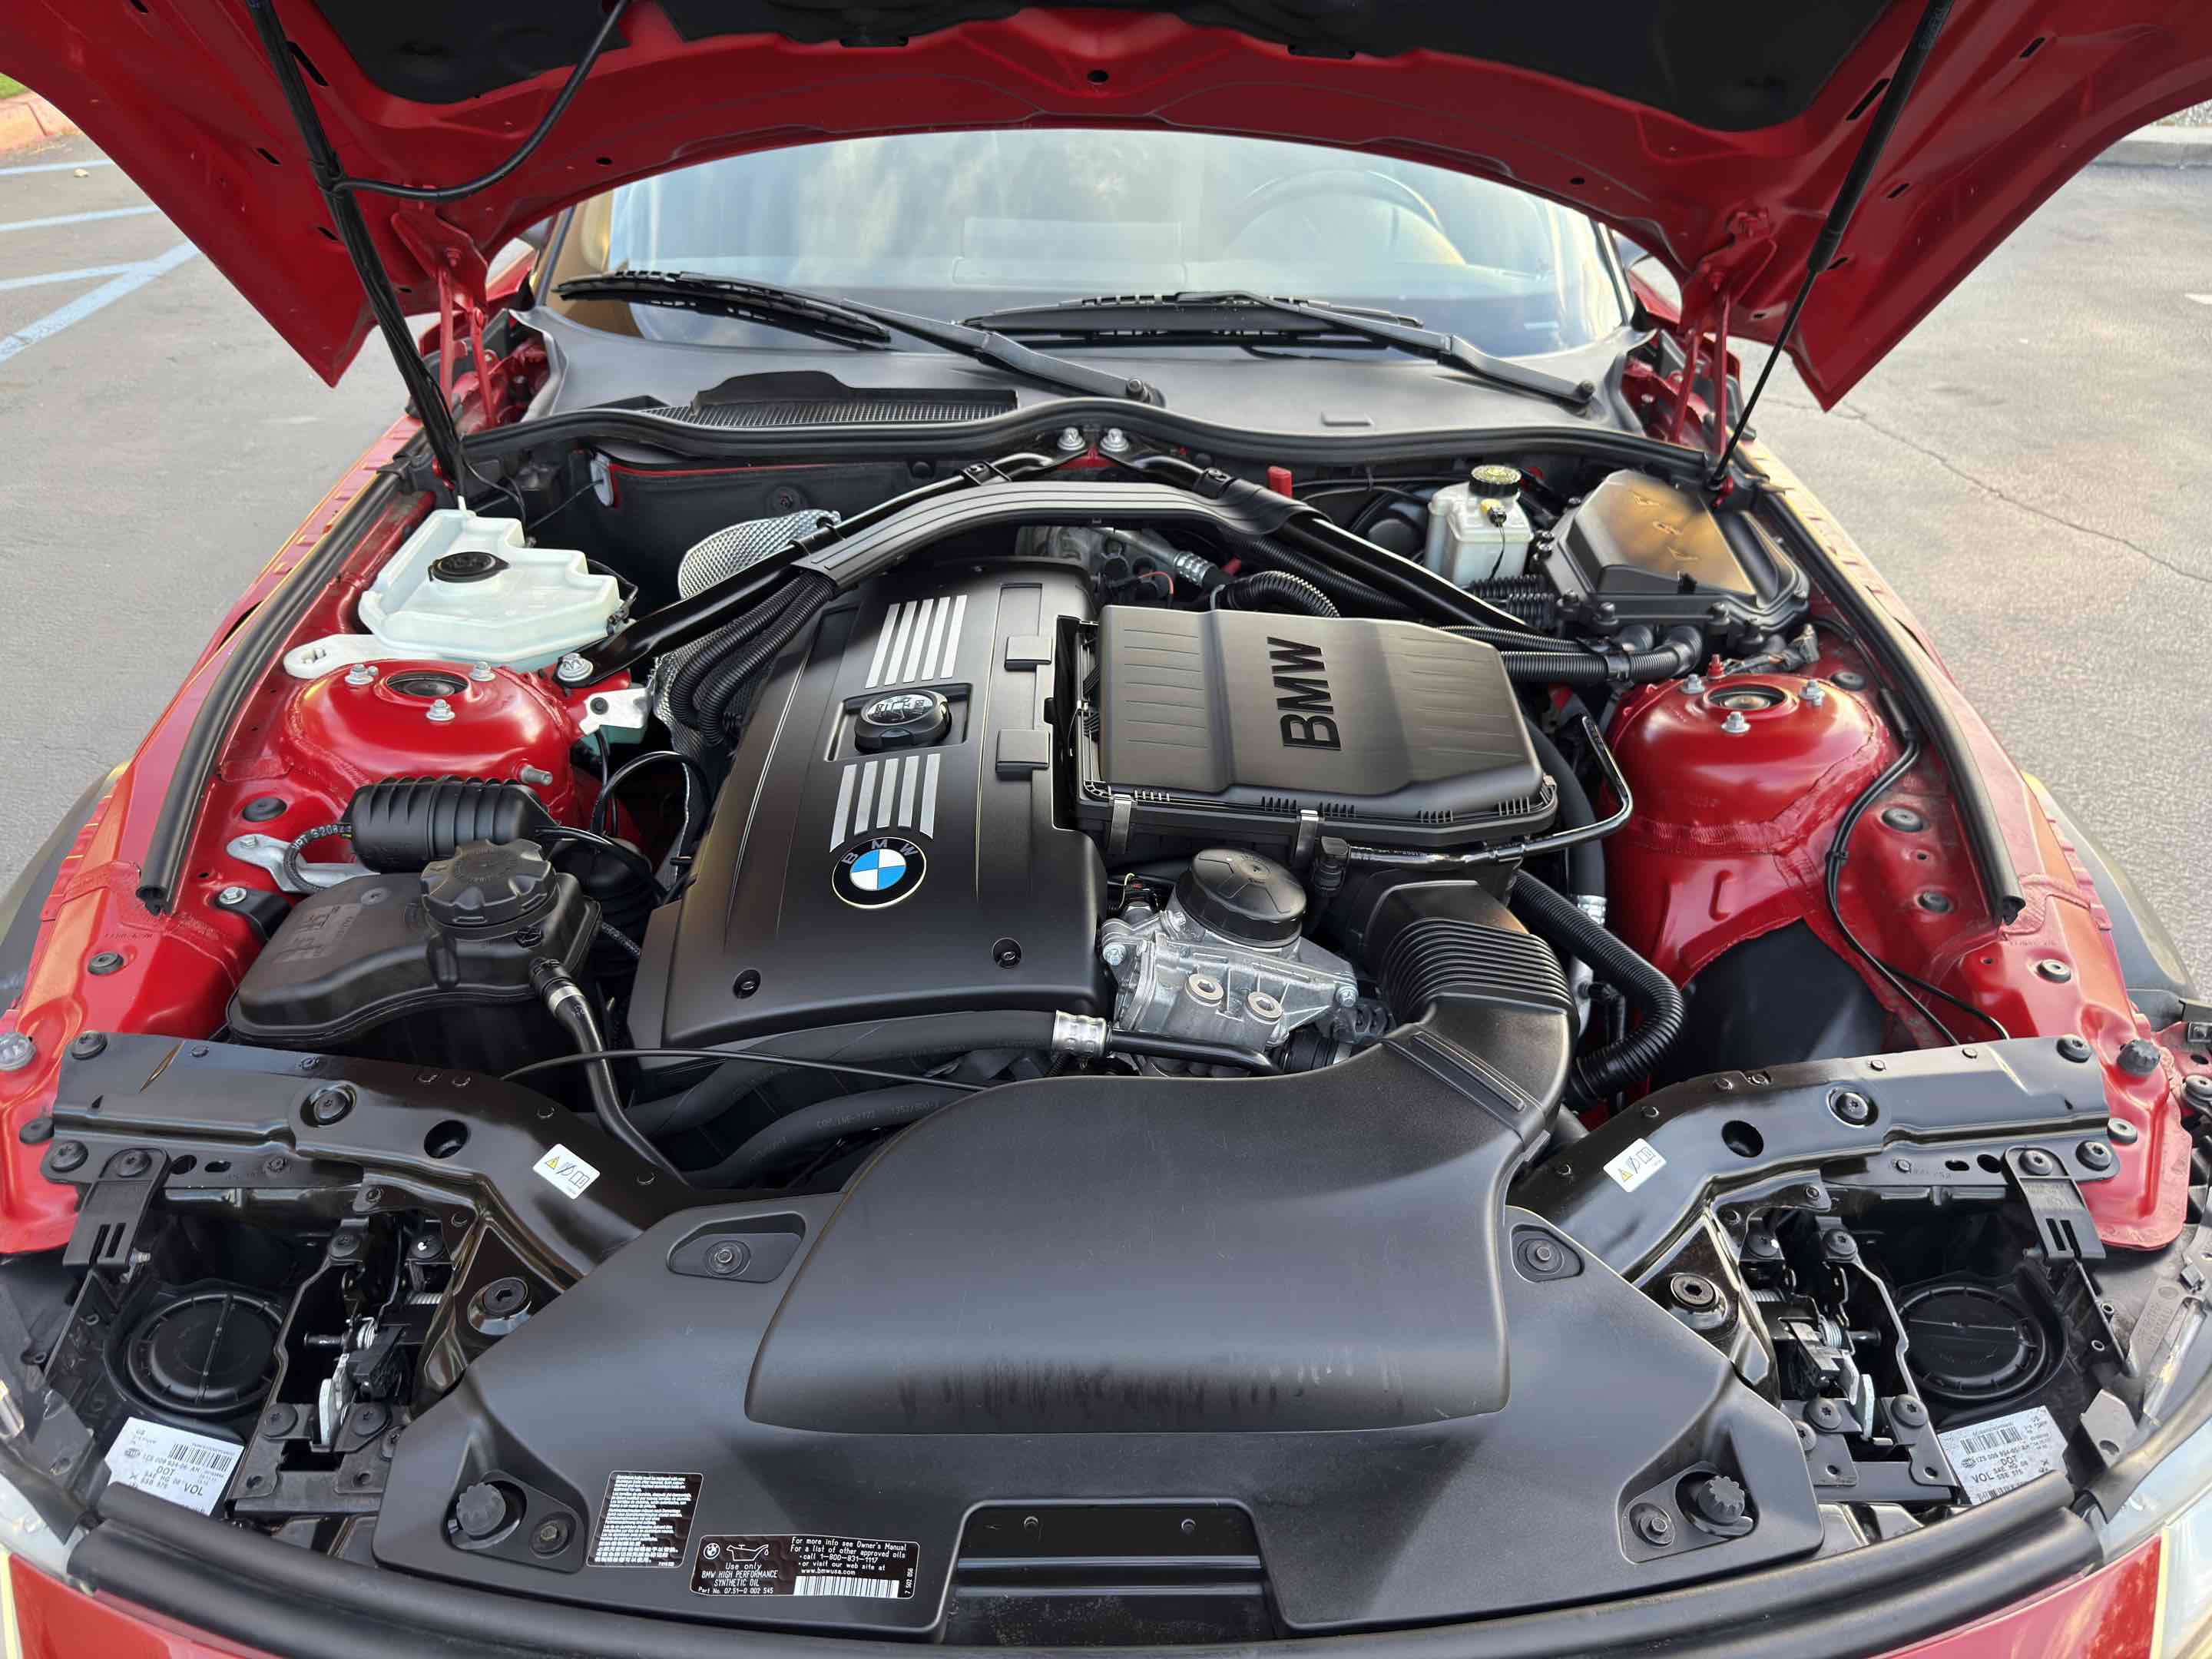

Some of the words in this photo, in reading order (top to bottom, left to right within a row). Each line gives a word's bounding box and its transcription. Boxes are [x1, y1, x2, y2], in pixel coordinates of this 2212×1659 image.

[1267, 637, 1342, 750] BMW
[842, 839, 919, 865] BMW
[2000, 1455, 2016, 1465] DOT
[157, 1465, 176, 1476] DOT
[1972, 1472, 1995, 1483] VOL
[184, 1482, 204, 1496] VOL
[792, 1536, 803, 1545] For
[857, 1541, 881, 1549] Owner's
[790, 1544, 801, 1552] For
[839, 1546, 856, 1555] other
[860, 1549, 889, 1558] approved
[820, 1553, 878, 1563] 1-800-831-1117
[744, 1562, 762, 1571] only
[801, 1567, 856, 1575] www.bmwusa.com
[736, 1570, 778, 1578] PERFORMANCE
[714, 1578, 747, 1587] SYNTHETIC
[750, 1578, 760, 1587] OIL
